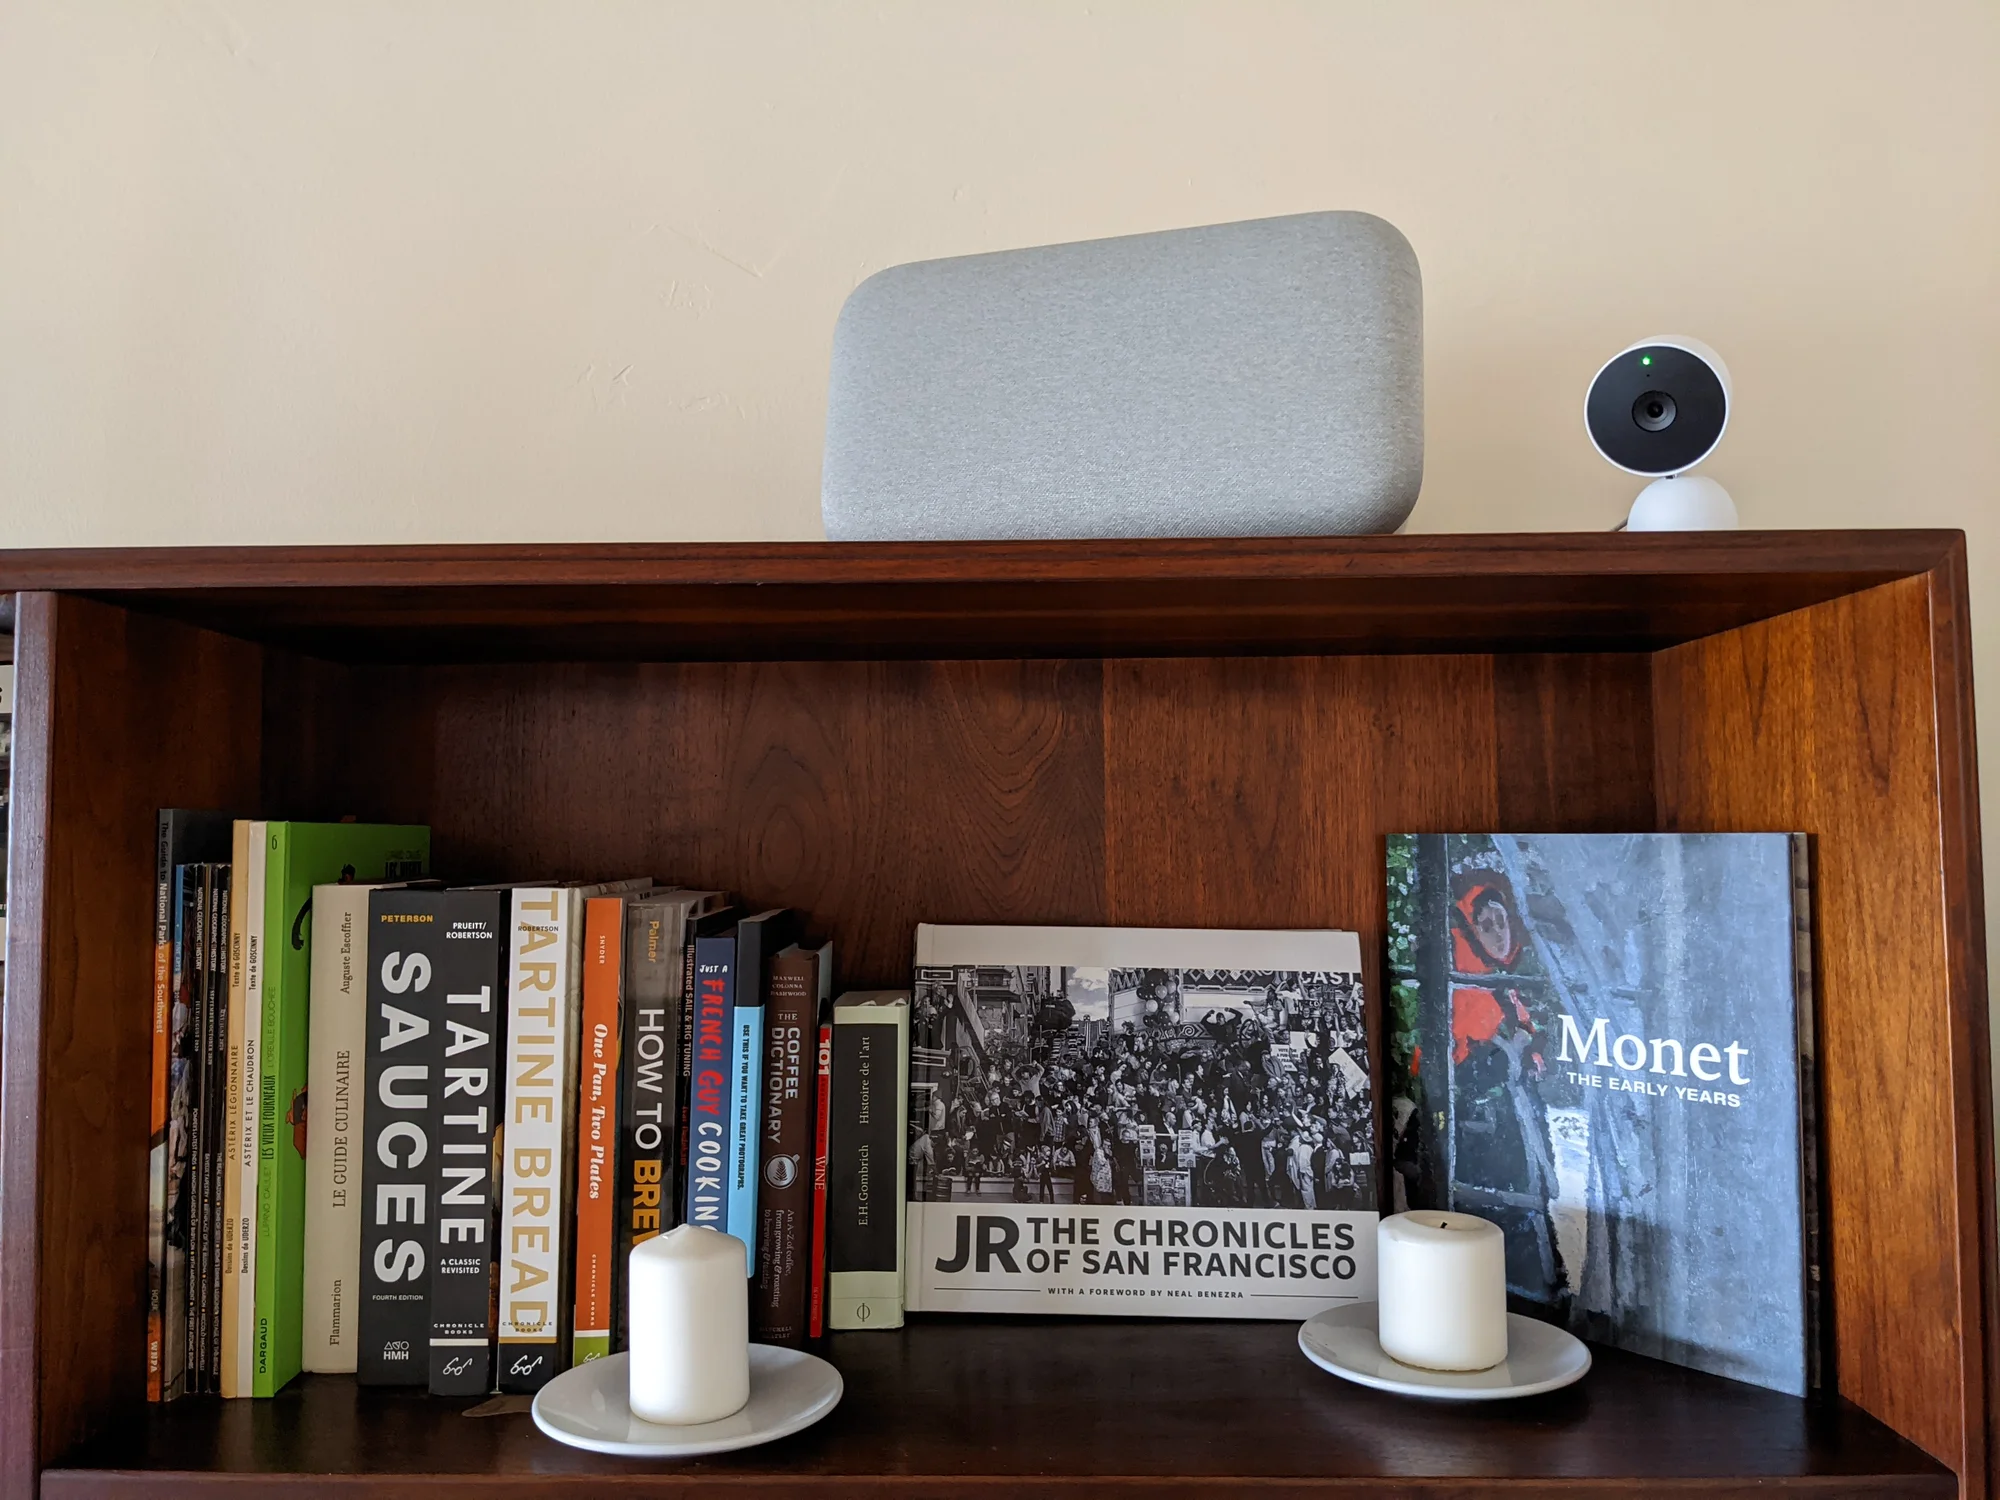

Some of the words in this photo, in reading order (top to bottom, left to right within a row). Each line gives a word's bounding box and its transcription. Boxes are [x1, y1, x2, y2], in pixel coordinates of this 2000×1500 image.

[160, 841, 168, 868] Guide
[271, 835, 277, 850] 6
[160, 871, 166, 880] to
[159, 883, 167, 922] National
[158, 925, 166, 950] Parks
[341, 912, 352, 954] Escoffier
[453, 922, 487, 930] PRUEITT/
[648, 920, 659, 962] Palmer
[158, 953, 164, 962] of
[685, 945, 695, 991] Illustrated
[700, 964, 719, 974] JUST
[722, 964, 728, 973] A
[232, 972, 240, 987] Texte
[249, 975, 257, 990] Texte
[340, 956, 353, 994] Auguste
[156, 984, 165, 1033] Southwest
[515, 890, 558, 1127] TARTINE
[684, 993, 694, 1012] SAIL
[698, 978, 726, 1061] FRENCH
[593, 1024, 608, 1058] One
[684, 1025, 692, 1040] RIG
[741, 1025, 749, 1037] USE
[741, 1038, 749, 1052] THIS
[859, 1037, 870, 1059] l'art
[246, 1040, 254, 1092] CHAUDRON
[637, 1008, 665, 1101] HOW
[683, 1042, 692, 1077] TUNING
[741, 1061, 749, 1074] YOU
[785, 1027, 800, 1099] COFFEE
[818, 1039, 830, 1075] 101
[1556, 1015, 1751, 1086] Monet
[229, 1046, 238, 1114] LÉGIONNAIRE
[589, 1062, 607, 1102] Pan,
[740, 1075, 748, 1093] WANT
[767, 1027, 784, 1144] DICTIONARY
[860, 1062, 870, 1076] de
[246, 1096, 253, 1105] LE
[262, 1075, 275, 1120] FOURNEAUX
[335, 1050, 350, 1131] CULINAIRE
[696, 1069, 724, 1116] GUY
[740, 1095, 748, 1103] TO
[859, 1080, 869, 1124] Histoire
[1567, 1072, 1603, 1090] THE
[1608, 1077, 1667, 1097] EARLY
[1674, 1086, 1741, 1108] YEARS
[246, 1111, 252, 1120] ET
[372, 951, 432, 1283] SAUCES
[440, 985, 490, 1245] TARTINE
[590, 1106, 606, 1140] Two
[634, 1103, 662, 1150] TO
[739, 1105, 747, 1120] TAKE
[227, 1120, 236, 1160] ASTÉRIX
[244, 1127, 252, 1167] ASTÉRIX
[262, 1123, 274, 1144] VIEUX
[738, 1122, 747, 1142] GREAT
[262, 1148, 274, 1159] LES
[333, 1136, 348, 1184] GUIDE
[737, 1143, 746, 1190] PHOTOGRAPHS.
[589, 1144, 604, 1199] Plates
[815, 1155, 825, 1190] WINE
[858, 1145, 869, 1200] Gombrich
[332, 1189, 346, 1208] LE
[765, 1209, 772, 1217] to
[776, 1209, 784, 1229] from
[786, 1224, 794, 1240] A-Z
[787, 1210, 794, 1222] An
[509, 1146, 552, 1334] BREAD
[763, 1218, 771, 1253] brewing
[773, 1231, 782, 1264] growing
[786, 1242, 794, 1250] of
[935, 1215, 1021, 1274] JR
[1027, 1217, 1100, 1245] THE
[1113, 1218, 1355, 1251] CHRONICLES
[241, 1252, 249, 1273] Dessins
[763, 1253, 770, 1262] &
[774, 1265, 782, 1273] &
[785, 1250, 793, 1276] coffee,
[1026, 1248, 1071, 1274] OF
[1082, 1249, 1150, 1276] SAN
[1163, 1251, 1357, 1280] FRANCISCO
[772, 1274, 781, 1308] roasting
[1047, 1286, 1075, 1296] WITH
[1078, 1287, 1086, 1296] A
[1089, 1287, 1146, 1297] FOREWORD
[1150, 1288, 1163, 1297] BY
[1166, 1288, 1194, 1298] NEAL
[1197, 1289, 1244, 1299] BENEZRA
[330, 1280, 342, 1346] Flammarion
[150, 1341, 158, 1372] WNPA
[259, 1318, 267, 1373] DARGAUD
[384, 1351, 409, 1360] HMH
